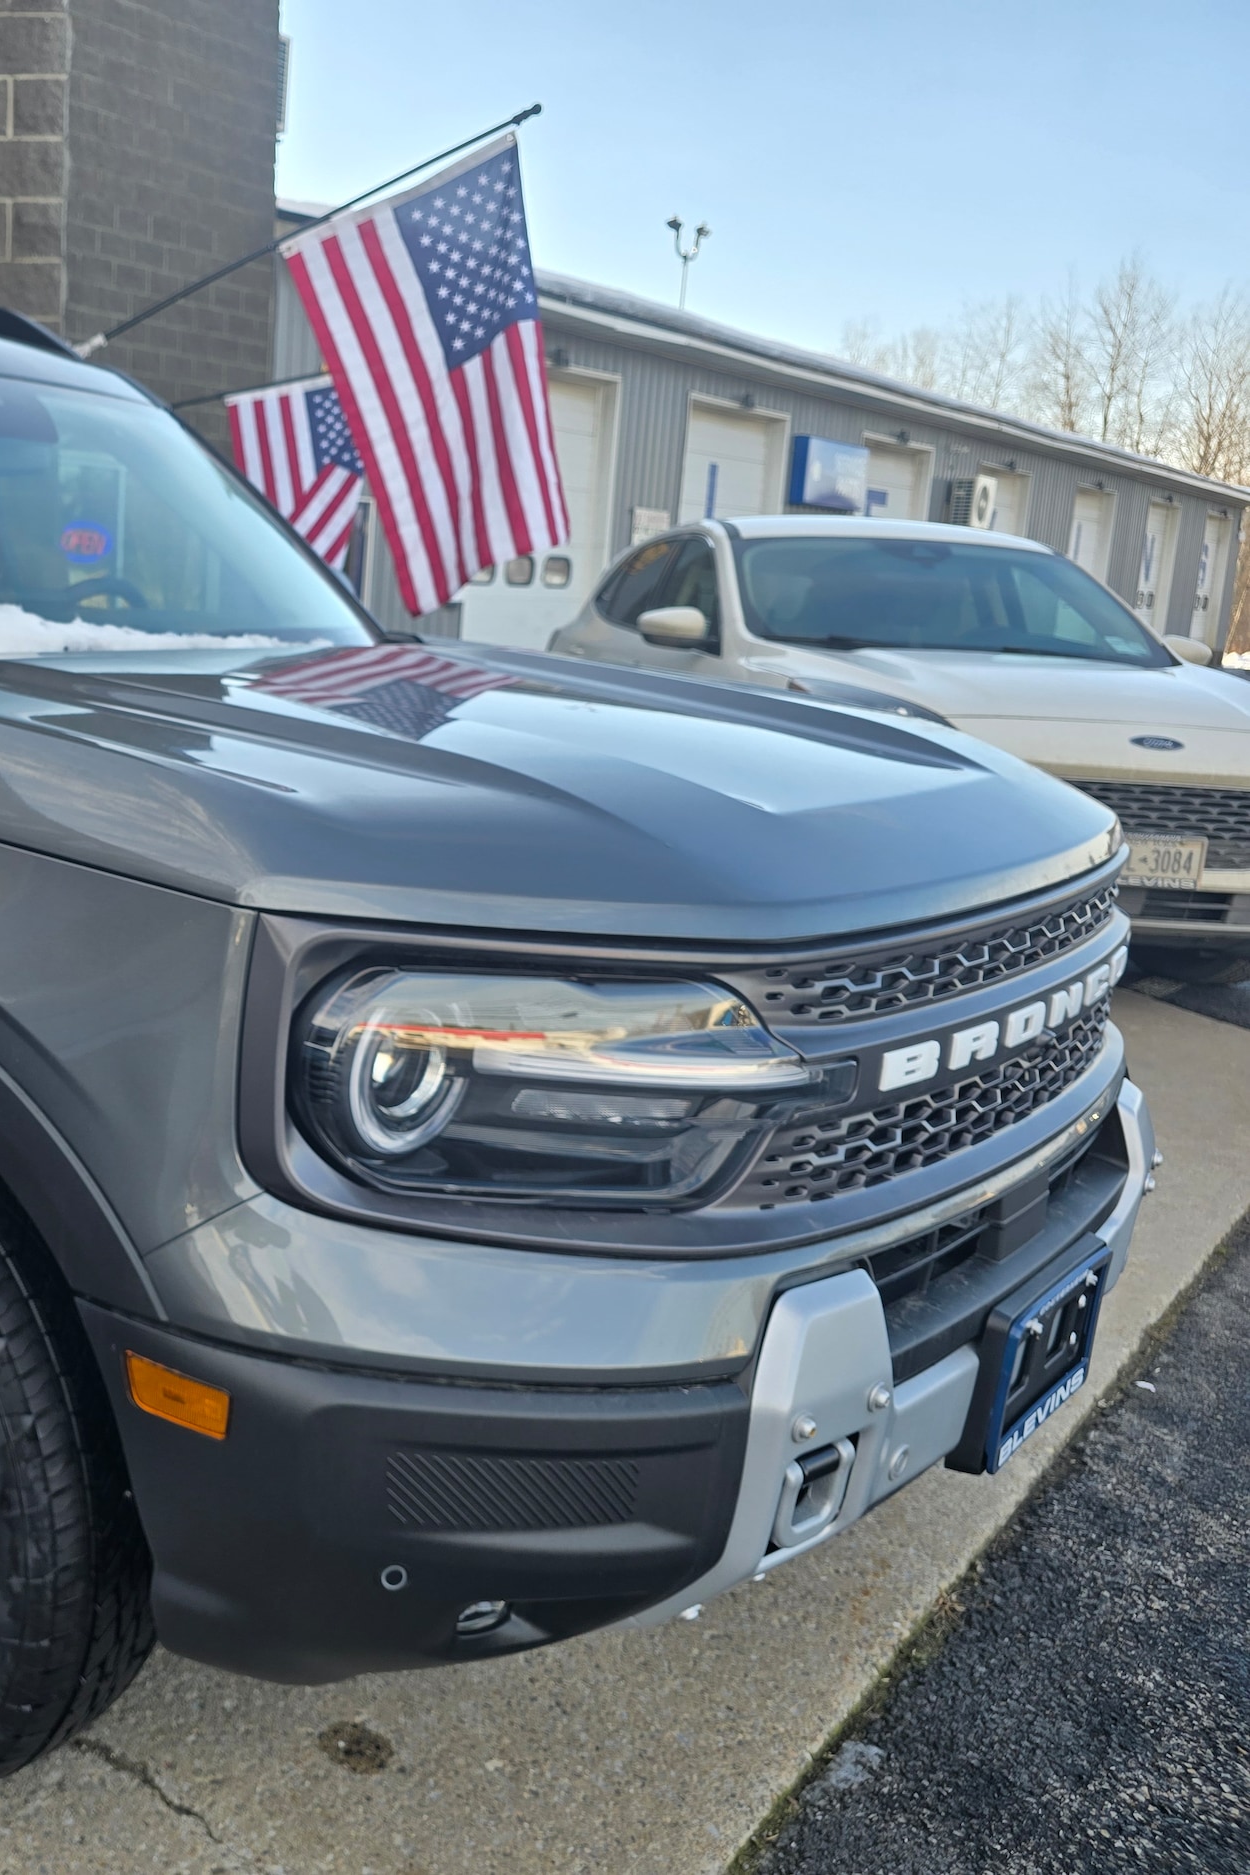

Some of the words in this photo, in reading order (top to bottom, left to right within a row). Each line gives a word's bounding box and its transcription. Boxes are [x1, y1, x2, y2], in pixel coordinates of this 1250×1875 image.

[61, 529, 107, 556] OPEN
[1149, 848, 1193, 874] 3084
[1116, 876, 1195, 890] LEVINS
[998, 1367, 1084, 1467] BLEVINS
